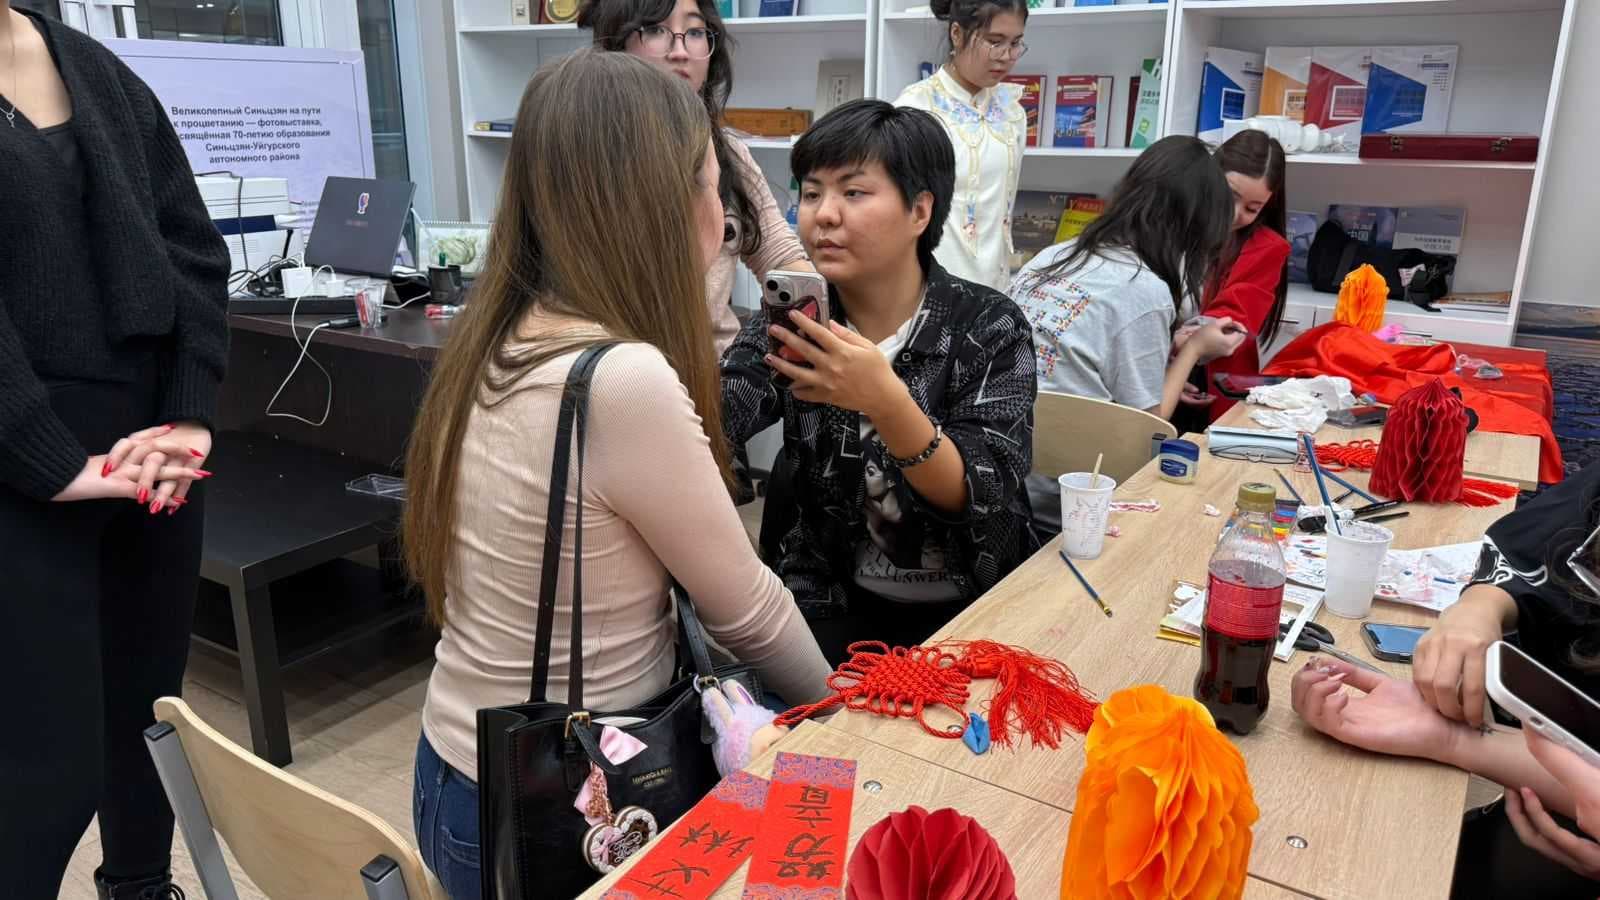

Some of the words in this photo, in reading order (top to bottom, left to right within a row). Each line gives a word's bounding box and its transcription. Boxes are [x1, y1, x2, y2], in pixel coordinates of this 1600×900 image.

[171, 106, 242, 115] Великолепный
[244, 106, 288, 115] Синьцзян
[302, 108, 321, 116] пути
[181, 120, 244, 129] процветанию
[257, 118, 323, 128] фотовыставка,
[180, 131, 231, 141] свящённая
[233, 129, 274, 139] 70-летию
[276, 129, 331, 138] образования
[205, 141, 301, 152] Синьцзян-Уйгурского
[209, 155, 268, 164] автономного
[269, 153, 301, 162] района
